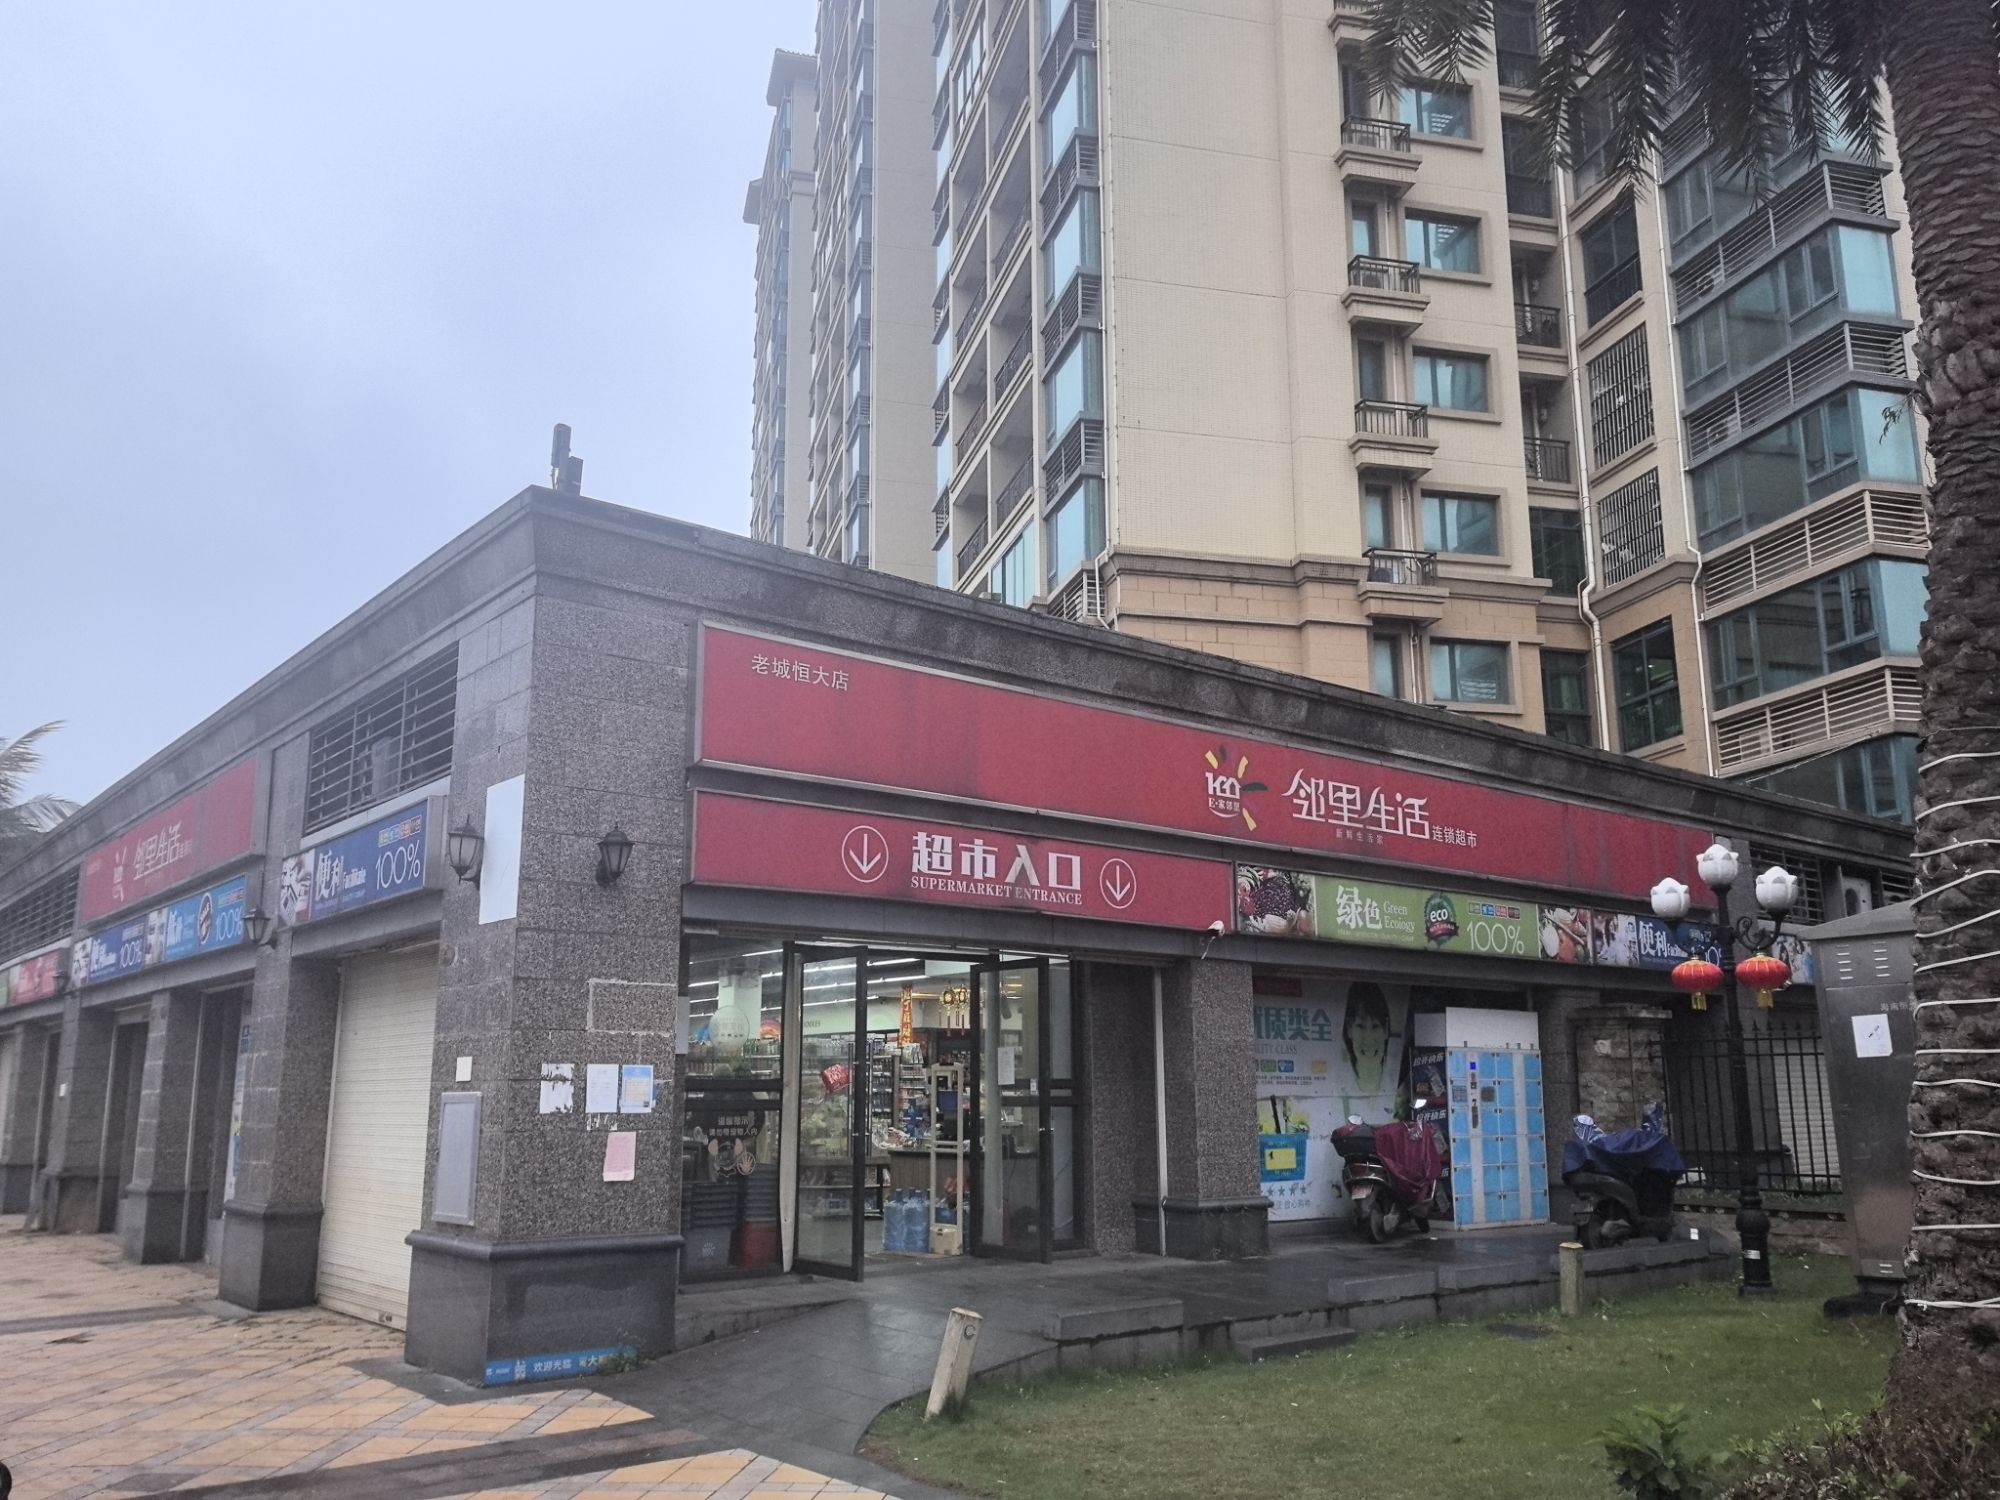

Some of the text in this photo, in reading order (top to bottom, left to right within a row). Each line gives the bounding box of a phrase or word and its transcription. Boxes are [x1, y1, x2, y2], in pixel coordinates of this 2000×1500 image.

[752, 654, 849, 691] 老城恒大店
[1281, 768, 1430, 840] 邻里生活
[1431, 825, 1478, 849] 连锁超市
[376, 839, 421, 891] 100%
[911, 831, 1081, 890] 超市入口
[911, 876, 1083, 905] SUPERMARKET ENTRANCE
[1335, 885, 1383, 930] 绿色
[1383, 901, 1408, 915] Green
[1429, 907, 1449, 923] eco
[1467, 921, 1525, 955] 100%
[1638, 920, 1668, 958] 便利
